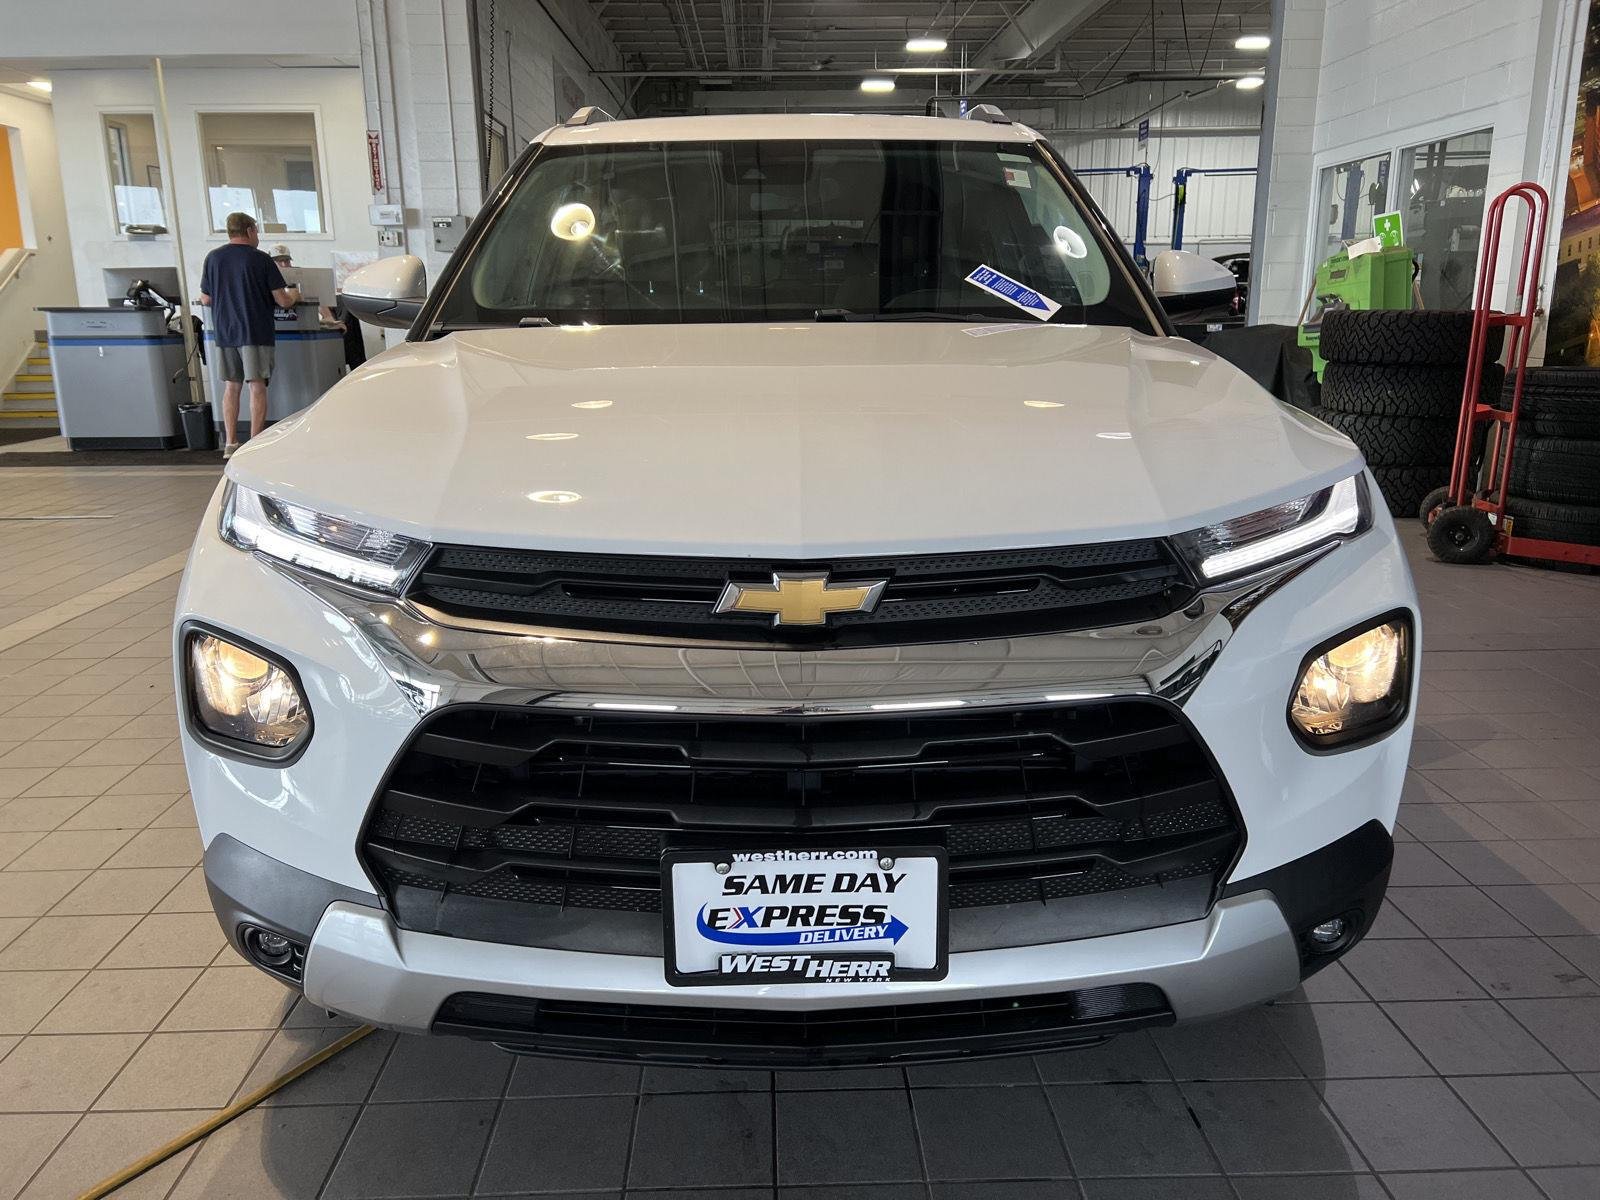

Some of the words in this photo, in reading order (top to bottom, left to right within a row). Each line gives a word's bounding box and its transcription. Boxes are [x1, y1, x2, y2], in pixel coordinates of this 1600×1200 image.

[732, 850, 878, 863] westherr.com
[722, 873, 827, 896] SAME
[831, 872, 907, 894] DAY
[707, 904, 888, 929] EXPRESS
[799, 924, 889, 944] DELIVERY
